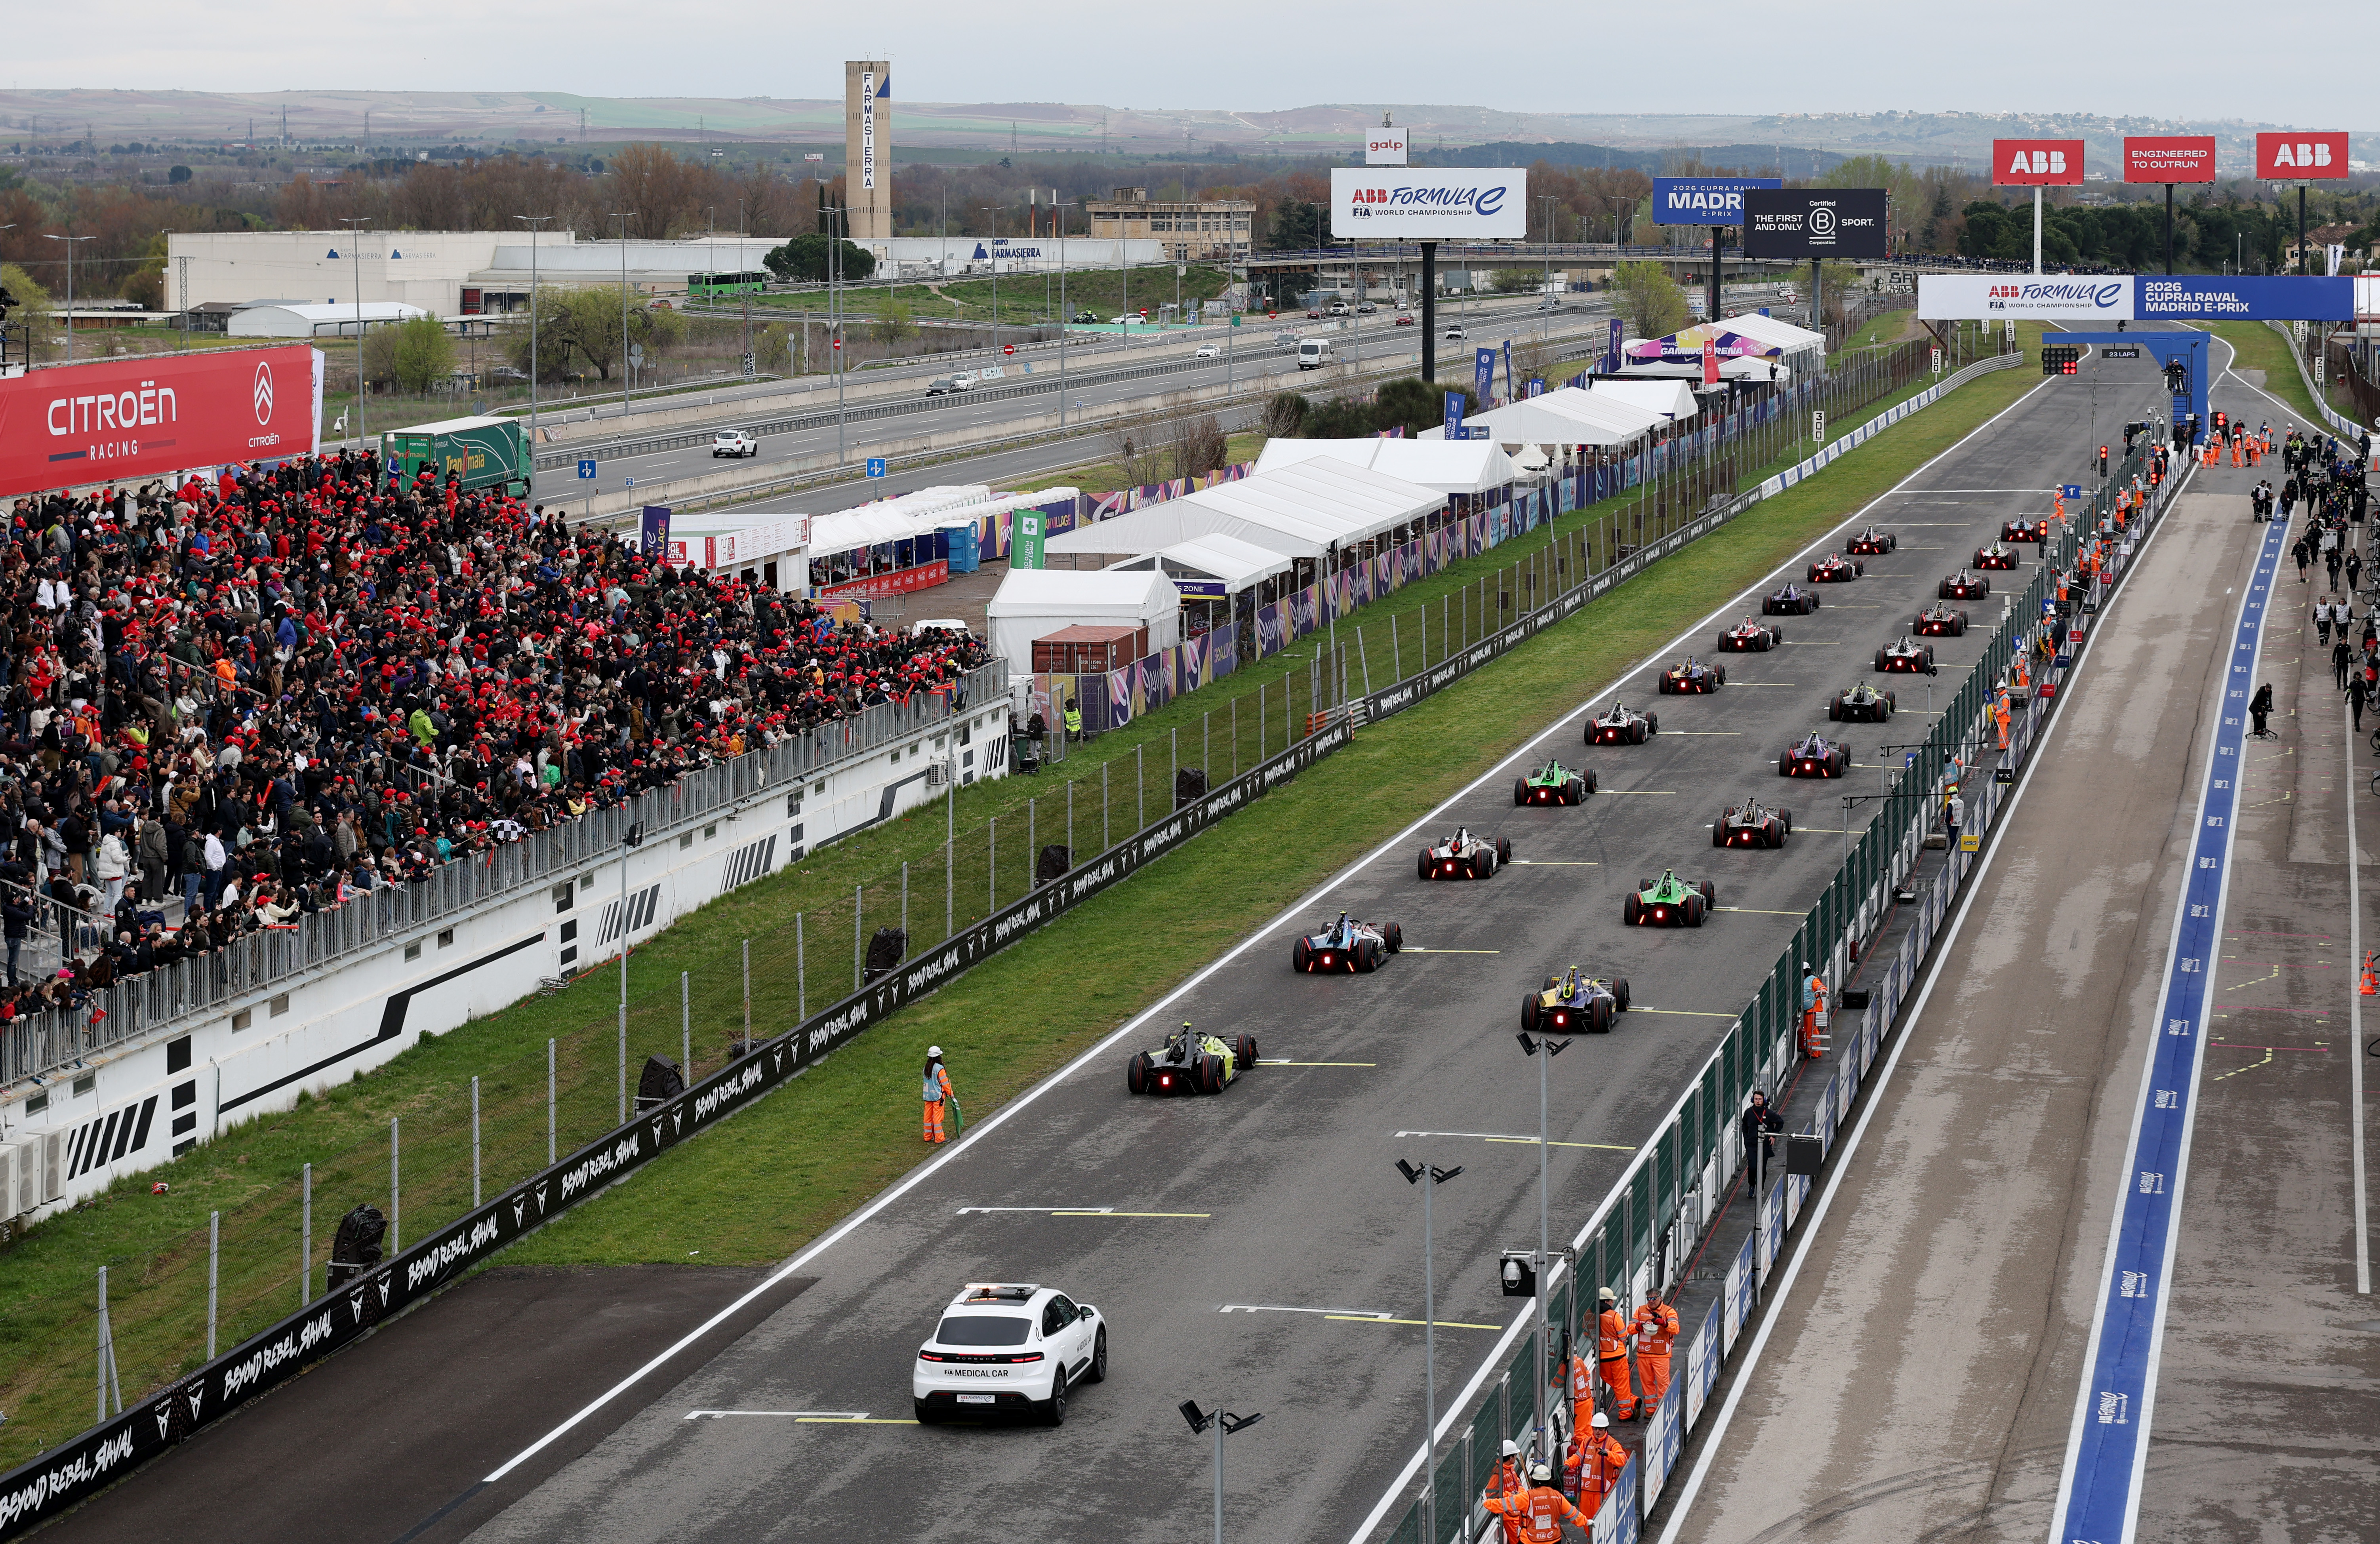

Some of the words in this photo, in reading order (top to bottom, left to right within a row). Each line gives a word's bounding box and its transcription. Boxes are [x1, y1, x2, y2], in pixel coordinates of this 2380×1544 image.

[864, 74, 872, 188] FARMASIERRA
[1370, 139, 1403, 152] galp
[2009, 151, 2066, 174] ABB
[2274, 143, 2332, 167] ABB
[1352, 189, 1387, 203] ABB
[1389, 187, 1477, 206] FORMULA
[1668, 192, 1744, 209] MADR
[1352, 206, 1372, 219] FIA
[1816, 213, 1829, 229] B
[992, 248, 1041, 258] FARMASIERRA
[1989, 285, 2020, 298] ABB
[2021, 284, 2095, 300] FORMULA
[2145, 282, 2182, 291] 2026
[2145, 293, 2191, 302] CUPRA
[2195, 293, 2239, 302] RAVAL
[1989, 300, 2006, 311] FIA
[2146, 303, 2201, 312] MADRID
[2204, 303, 2249, 312] E-PRIX
[48, 381, 176, 436] CITROËN
[249, 433, 280, 448] CITROËN
[90, 440, 138, 461] RACING
[809, 1022, 830, 1054] BEYOND
[695, 1087, 719, 1122] BEYOND
[652, 1114, 663, 1123] CUPRA
[536, 1179, 548, 1190] CUPRA
[562, 1160, 588, 1200] BEYOND
[513, 1193, 525, 1203] CUPRA
[377, 1269, 392, 1281] CUPRA
[408, 1247, 440, 1291] BEYOND
[350, 1285, 364, 1297] CUPRA
[223, 1351, 263, 1401] BEYOND
[187, 1378, 205, 1393] CUPRA
[155, 1397, 172, 1412] CUPRA
[0, 1475, 47, 1529] BEYOND
